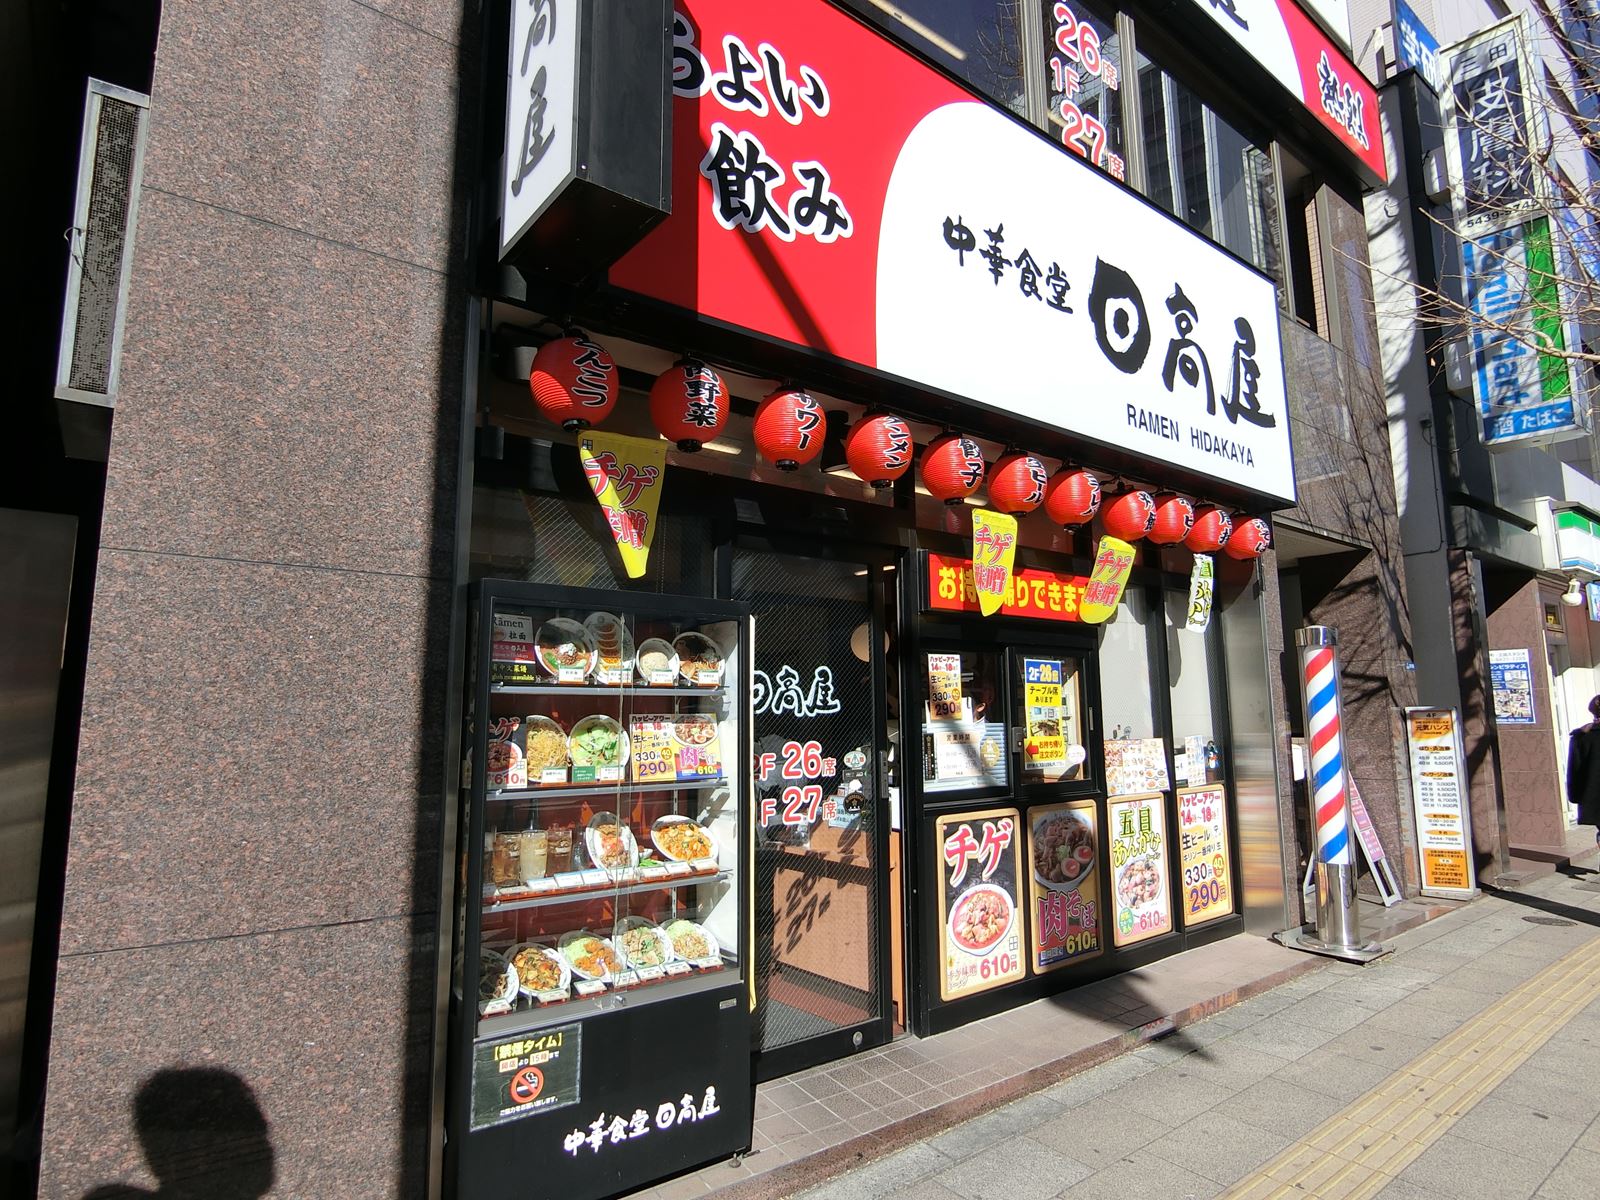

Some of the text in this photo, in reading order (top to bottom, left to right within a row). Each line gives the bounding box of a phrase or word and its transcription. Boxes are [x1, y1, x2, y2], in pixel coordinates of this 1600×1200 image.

[1055, 3, 1118, 90] 26席
[1460, 43, 1507, 75] 三田
[1051, 58, 1080, 98] 1F
[1061, 101, 1125, 180] 27席
[703, 126, 851, 240] 飲み
[943, 214, 1074, 314] 中華食堂
[1088, 255, 1276, 428] 日高屋
[1127, 403, 1255, 468] RAMEN HIDAKAYA
[1521, 407, 1566, 428] たばこ
[581, 451, 660, 508] チゲ
[957, 437, 983, 489] 餃子
[975, 525, 1014, 565] チゲ
[1092, 548, 1132, 583] チゲ
[782, 741, 837, 779] 26席
[782, 785, 838, 823] 27席
[1179, 791, 1221, 809] ハッピーアワー
[944, 817, 1014, 888] チゲ
[1112, 832, 1162, 868] あんかけ
[1182, 830, 1211, 851] 生ビール
[1037, 889, 1096, 946] 肉そば
[1066, 930, 1098, 954] 610円
[979, 952, 1018, 979] 610円
[563, 1085, 722, 1156] 中華食堂 日高屋
